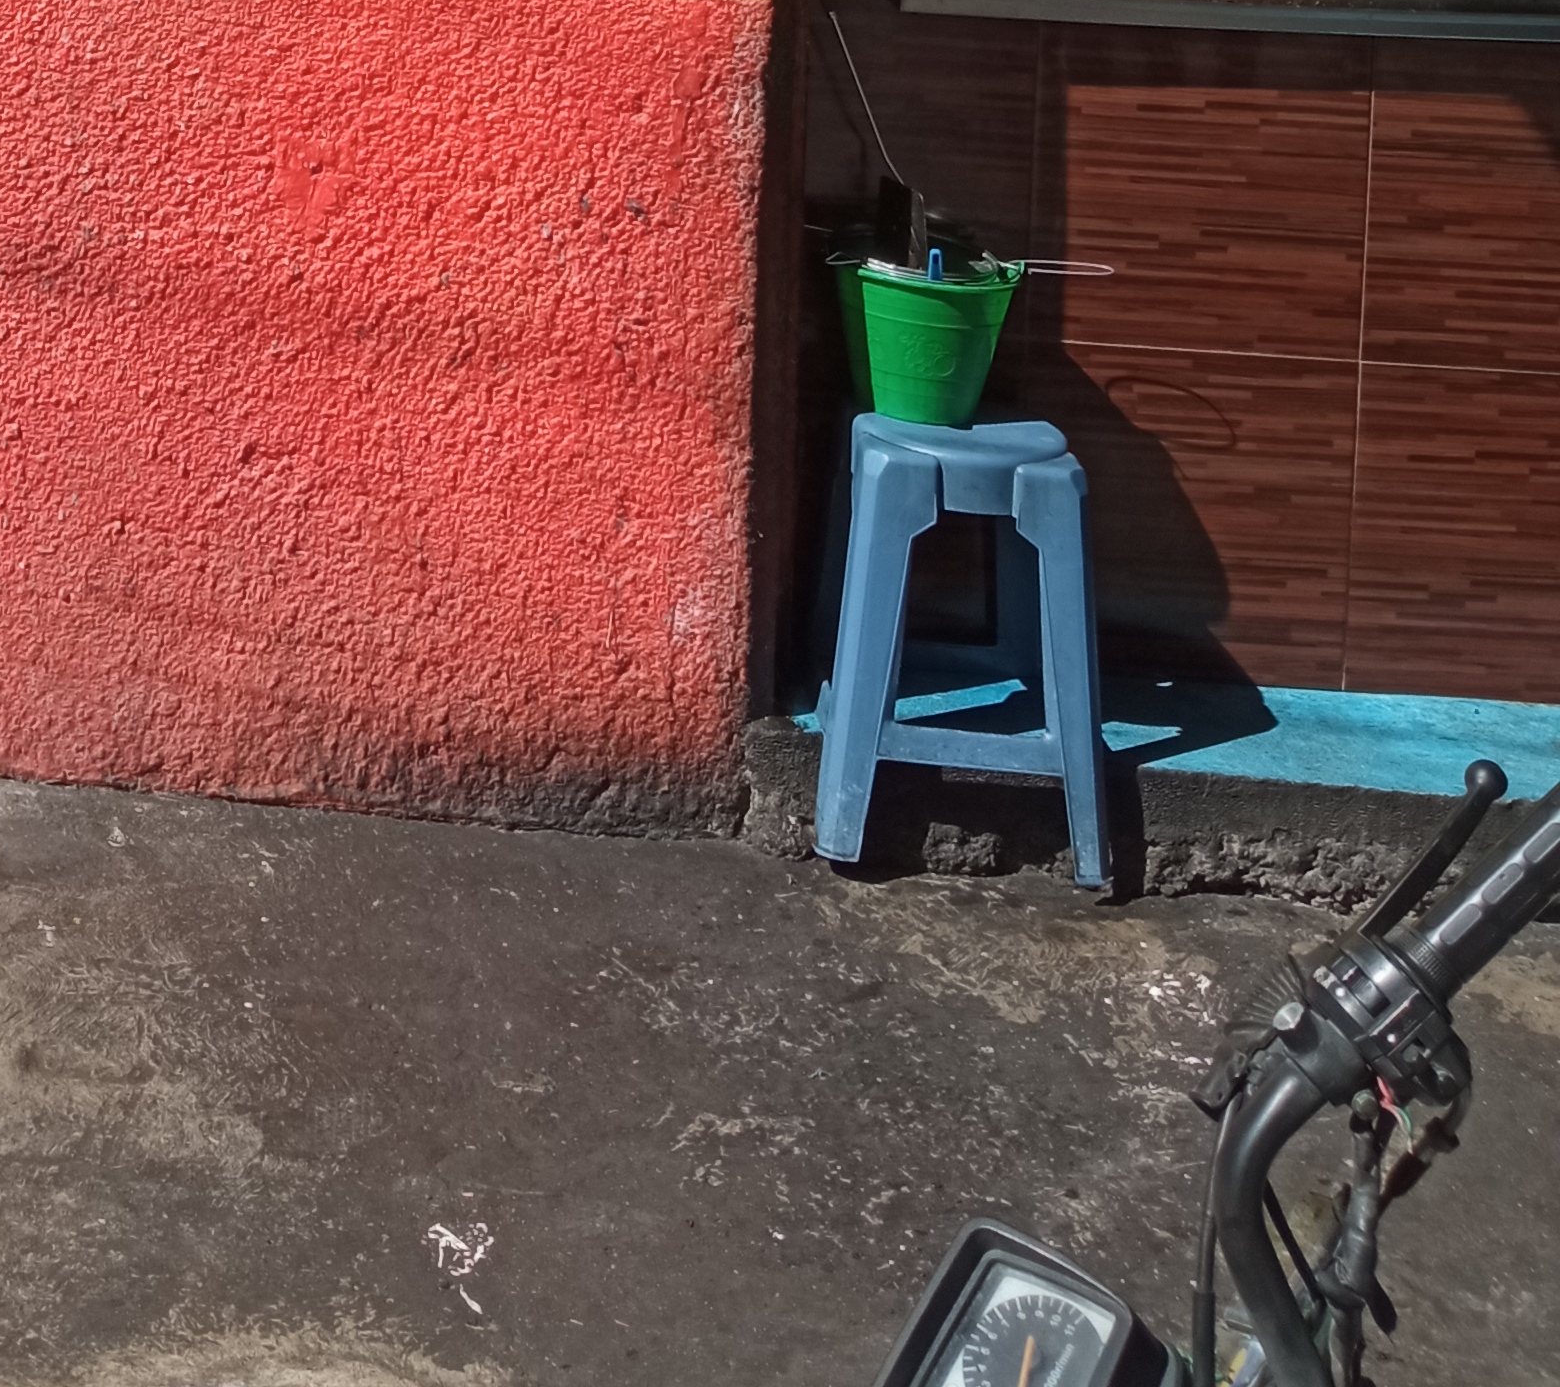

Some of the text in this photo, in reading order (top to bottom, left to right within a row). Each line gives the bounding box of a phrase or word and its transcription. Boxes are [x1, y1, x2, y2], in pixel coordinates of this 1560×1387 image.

[1016, 1311, 1026, 1320] 8
[1034, 1309, 1044, 1318] 9
[1049, 1314, 1061, 1326] 10
[1064, 1324, 1076, 1336] 11
